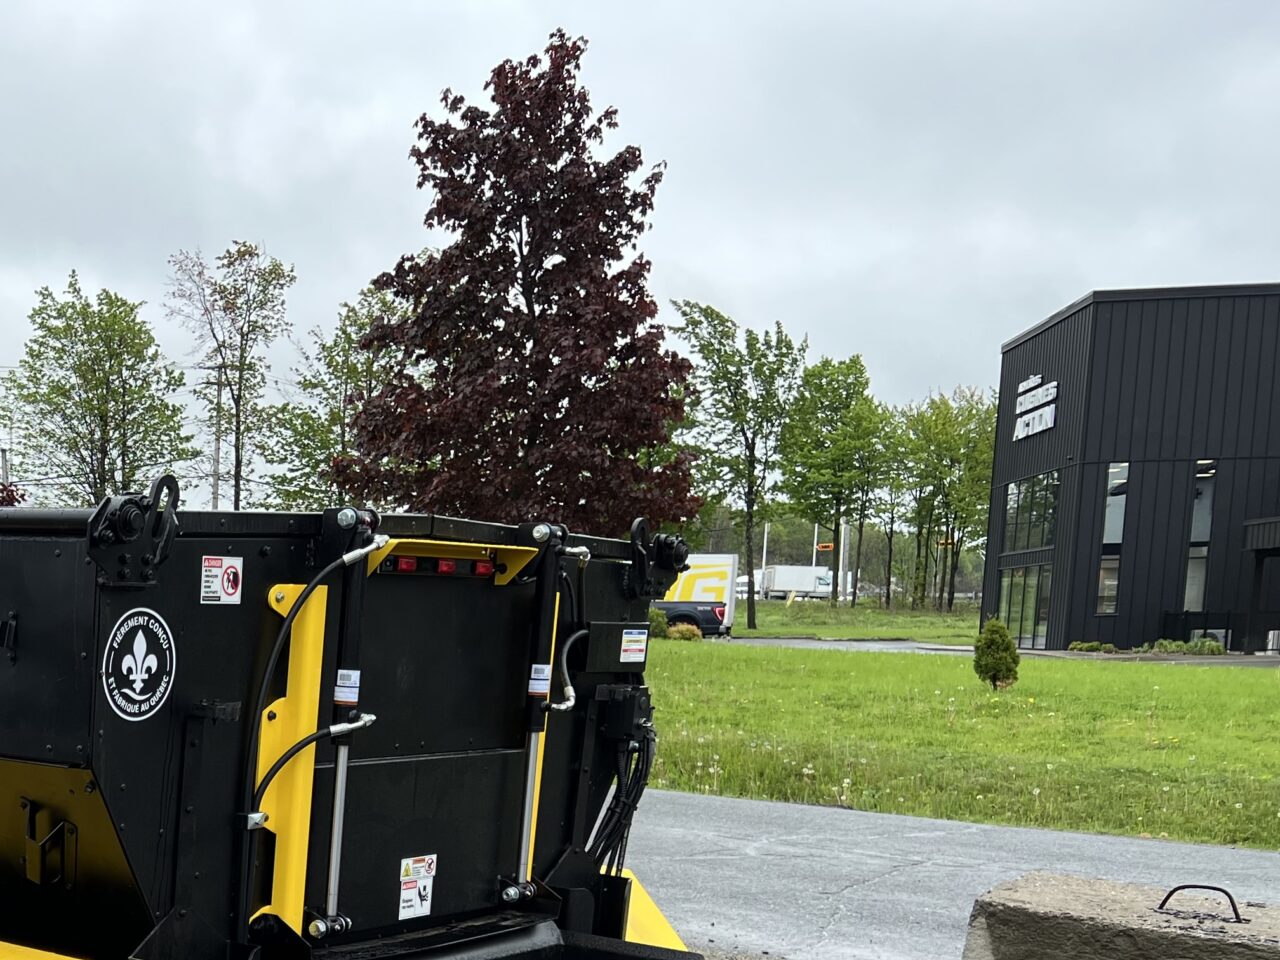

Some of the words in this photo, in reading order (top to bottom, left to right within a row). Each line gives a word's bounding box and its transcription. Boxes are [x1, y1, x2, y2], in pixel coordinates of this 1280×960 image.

[113, 616, 149, 649] FIÈREMENT
[148, 619, 169, 649] CONÇU
[108, 676, 116, 689] ET
[112, 689, 140, 713] FABRIQUÉ
[140, 702, 150, 713] AU
[150, 675, 169, 706] QUÉBEC
